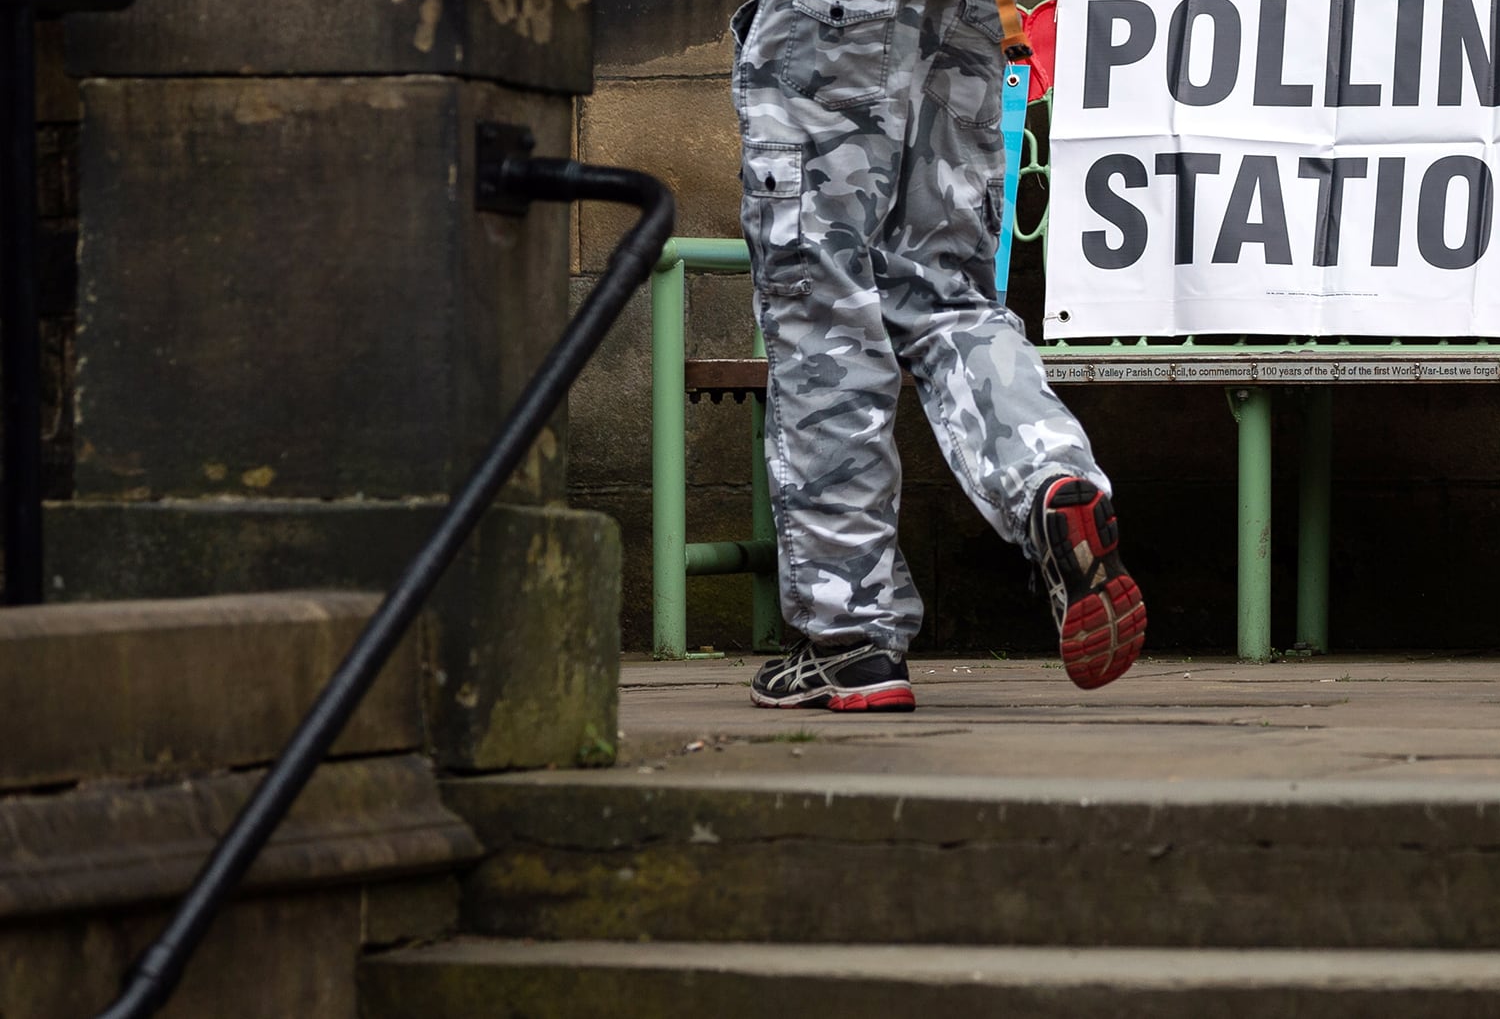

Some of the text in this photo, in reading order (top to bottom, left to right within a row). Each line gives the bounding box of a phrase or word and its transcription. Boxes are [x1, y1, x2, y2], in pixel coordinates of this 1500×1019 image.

[1056, 368, 1066, 379] by
[1097, 368, 1124, 379] Valley
[1126, 367, 1153, 376] Parish
[1261, 366, 1277, 376] 100
[1278, 368, 1301, 377] years
[1303, 366, 1313, 375] of
[1314, 366, 1327, 375] the
[1347, 366, 1357, 375] of
[1358, 366, 1371, 375] the
[1373, 366, 1390, 375] first
[1473, 364, 1498, 376] forget
